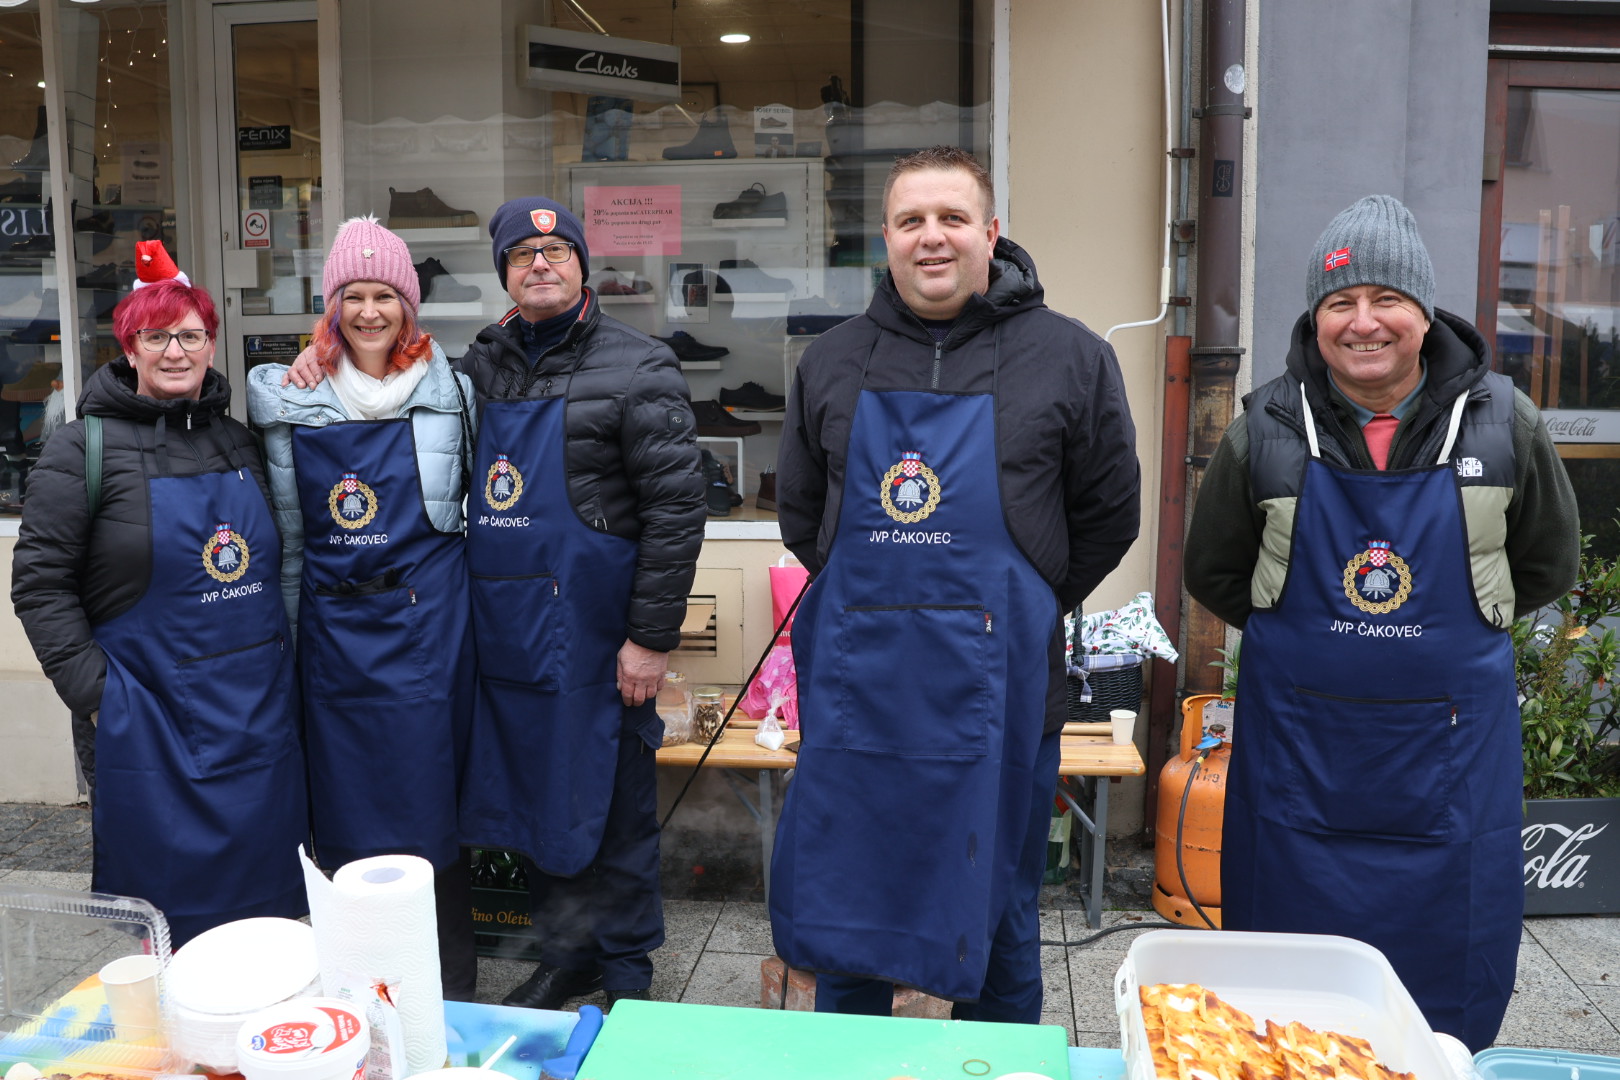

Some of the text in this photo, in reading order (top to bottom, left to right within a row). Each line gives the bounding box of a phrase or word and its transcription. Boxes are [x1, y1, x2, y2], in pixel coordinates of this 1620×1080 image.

[575, 52, 638, 78] Clarks
[611, 197, 653, 206] AKCIJA !!!
[593, 218, 609, 226] 30%
[490, 514, 530, 528] ČAKOVEC
[329, 533, 388, 545] JVP ČAKOVEC
[870, 529, 951, 544] JVP ČAKOVEC
[201, 581, 263, 603] JVP ČAKOVEC
[1330, 619, 1422, 638] JVP ČAKOVEC
